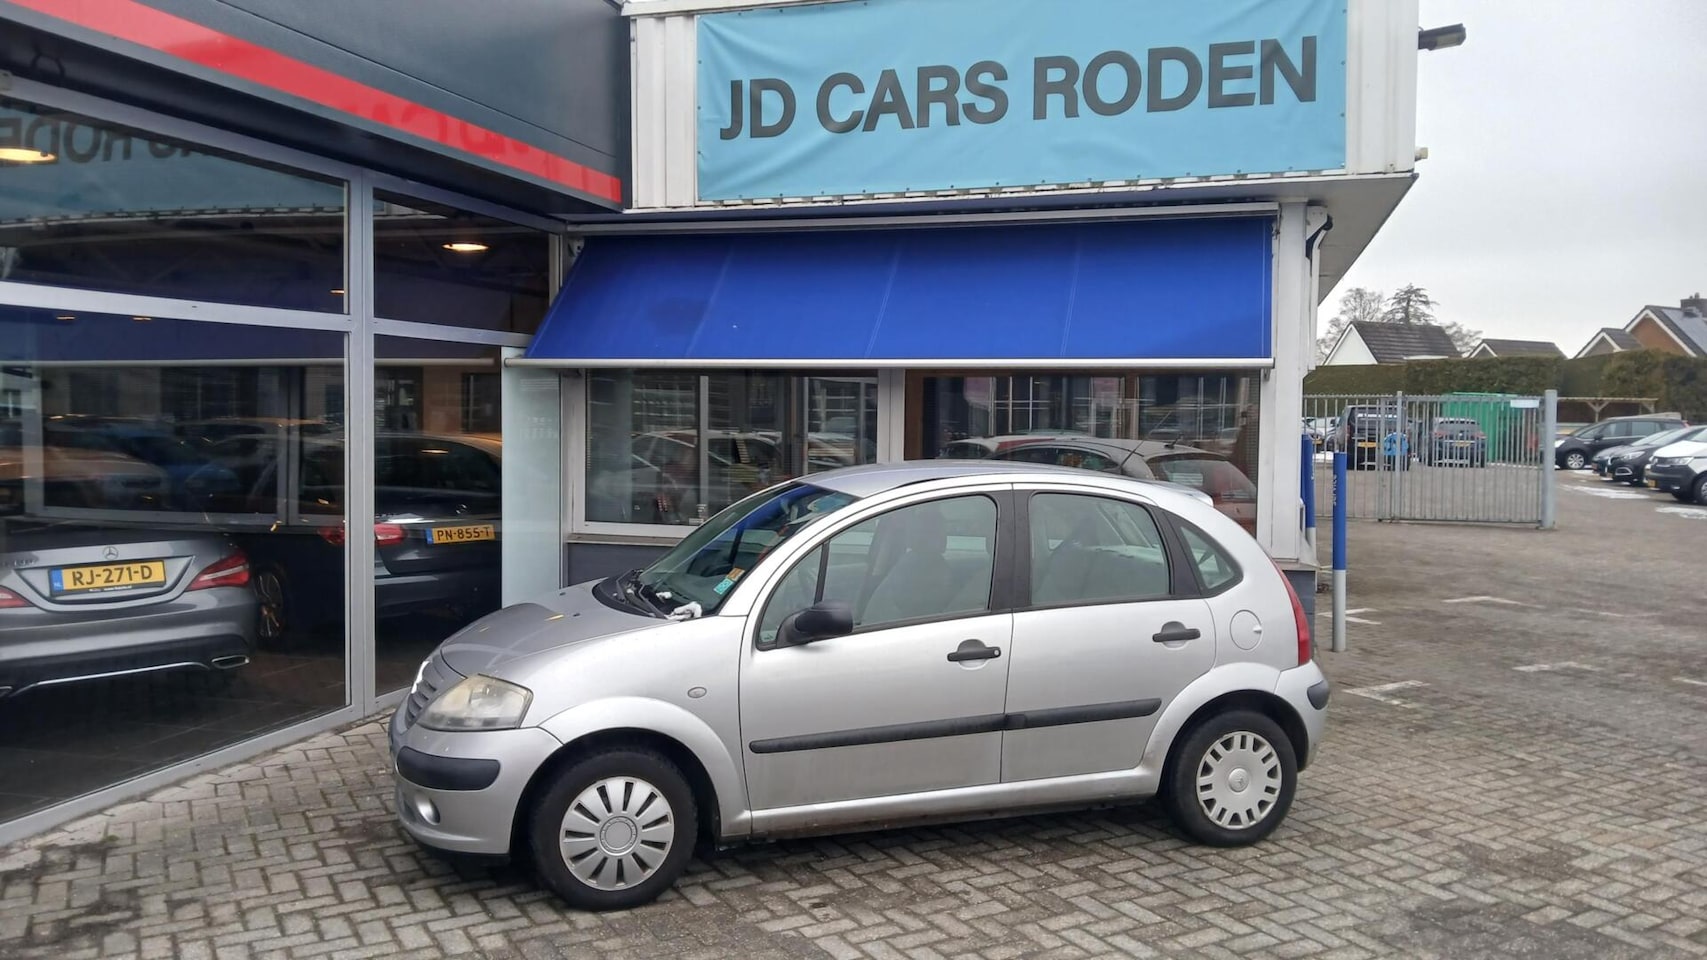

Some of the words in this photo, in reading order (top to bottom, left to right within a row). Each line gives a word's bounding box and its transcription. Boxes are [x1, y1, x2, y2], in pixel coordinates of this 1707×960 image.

[720, 77, 797, 140] JD
[816, 60, 1008, 134] CARS
[1033, 36, 1317, 120] RODEN
[437, 527, 490, 541] PN-855-T
[72, 565, 153, 586] RJ-271-D
